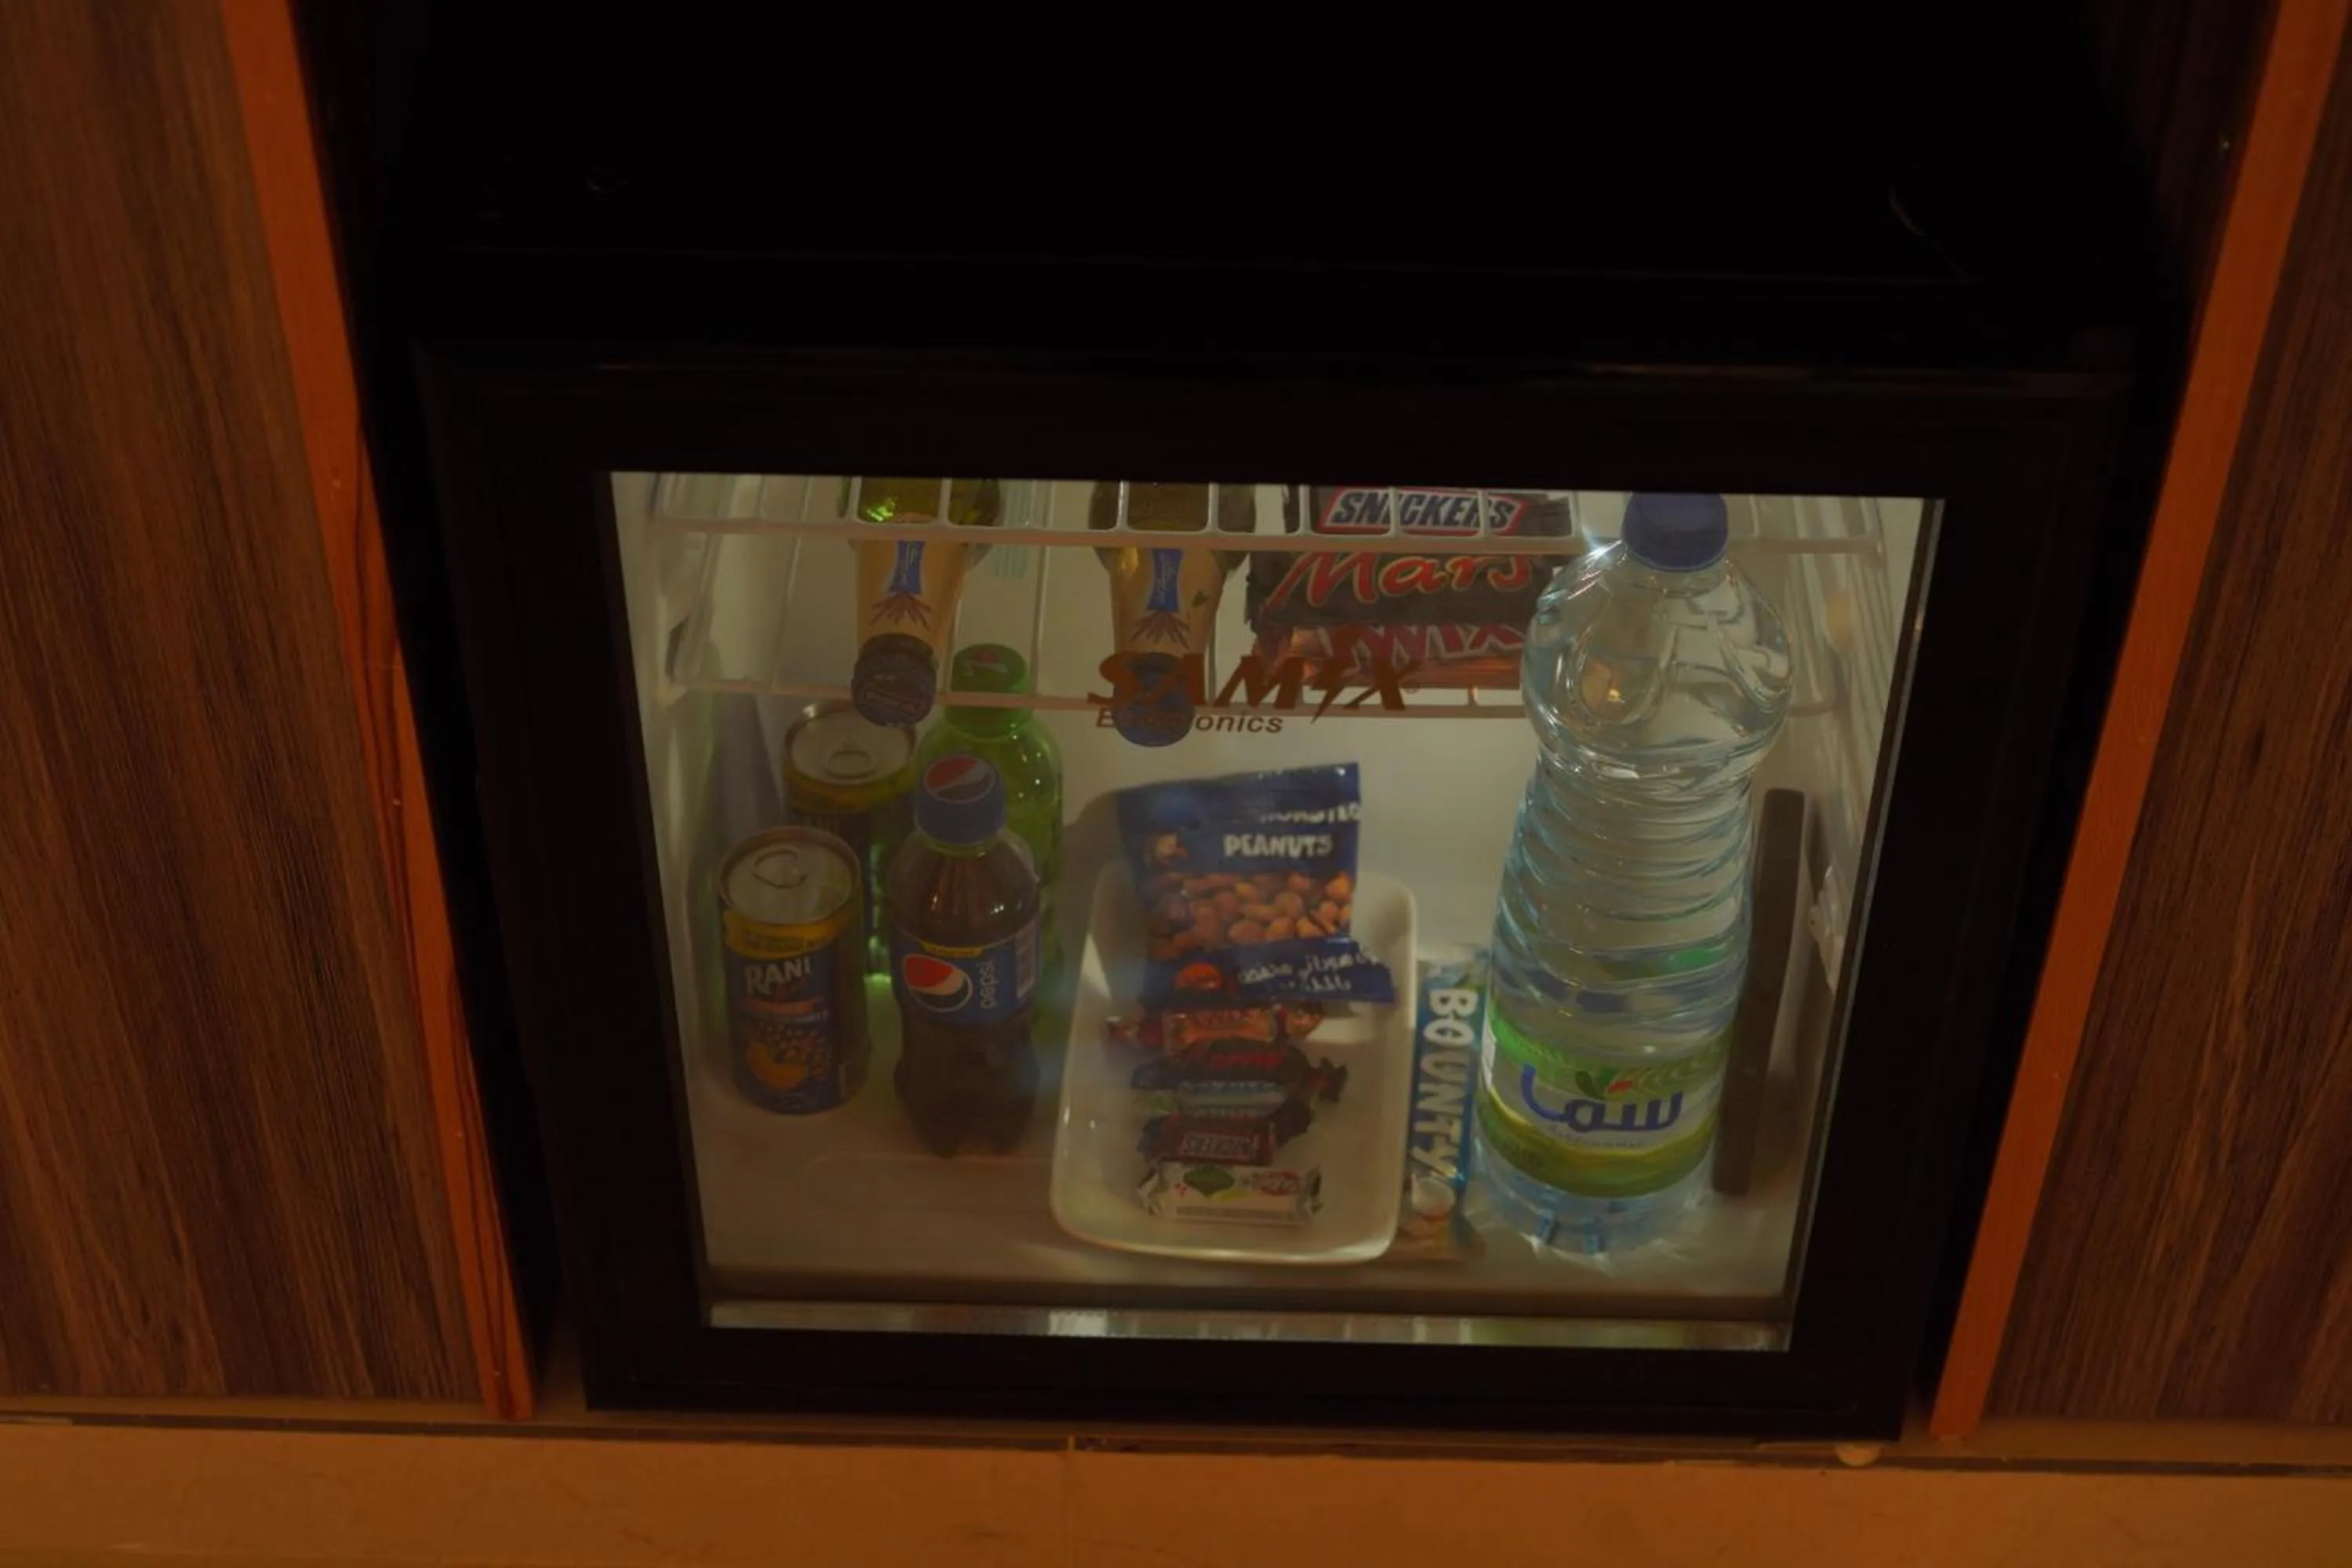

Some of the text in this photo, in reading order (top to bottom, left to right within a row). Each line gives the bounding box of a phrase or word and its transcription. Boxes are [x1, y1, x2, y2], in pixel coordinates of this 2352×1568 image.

[1265, 550, 1534, 608] Mars
[1222, 832, 1334, 859] PEANUTS
[743, 955, 815, 996] RANI
[975, 958, 1001, 1011] pepsi
[1409, 987, 1479, 1178] BOUNTY
